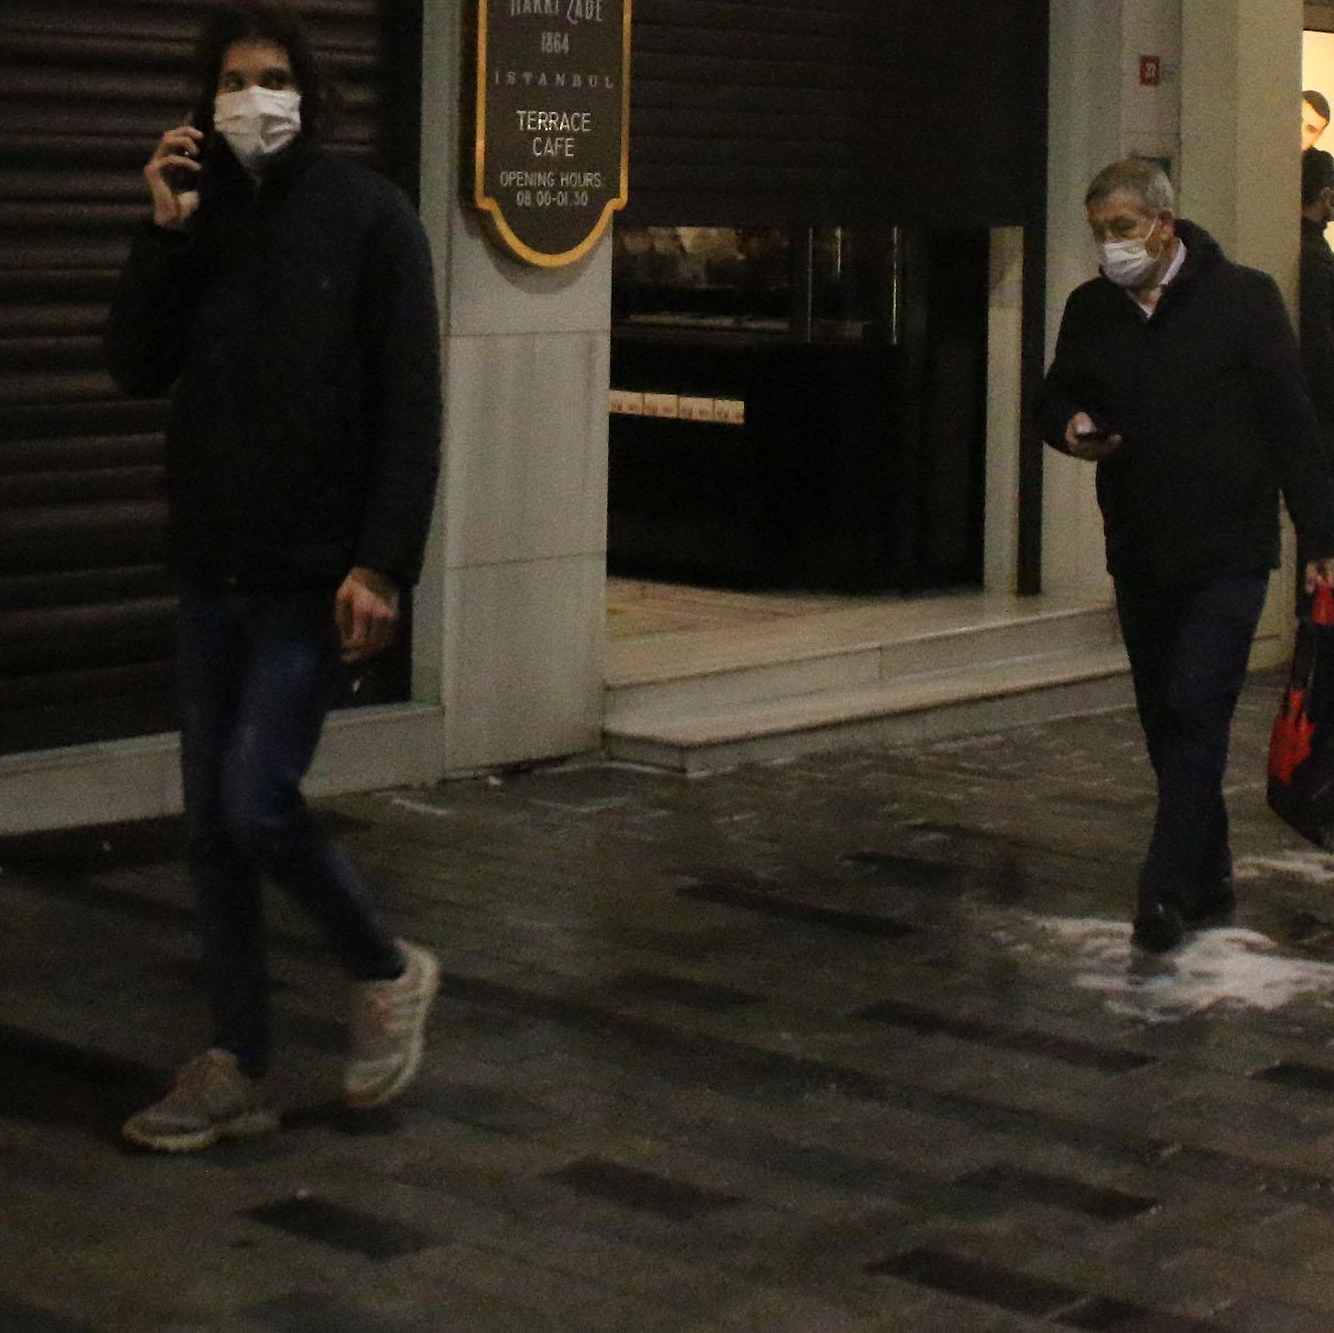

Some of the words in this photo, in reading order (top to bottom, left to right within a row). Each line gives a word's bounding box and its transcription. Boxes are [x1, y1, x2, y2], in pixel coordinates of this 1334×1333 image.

[540, 31, 570, 55] 1864
[516, 109, 592, 133] TERRACE
[531, 137, 575, 158] CAFE
[499, 170, 555, 188] OPENING
[560, 171, 602, 188] HOURS
